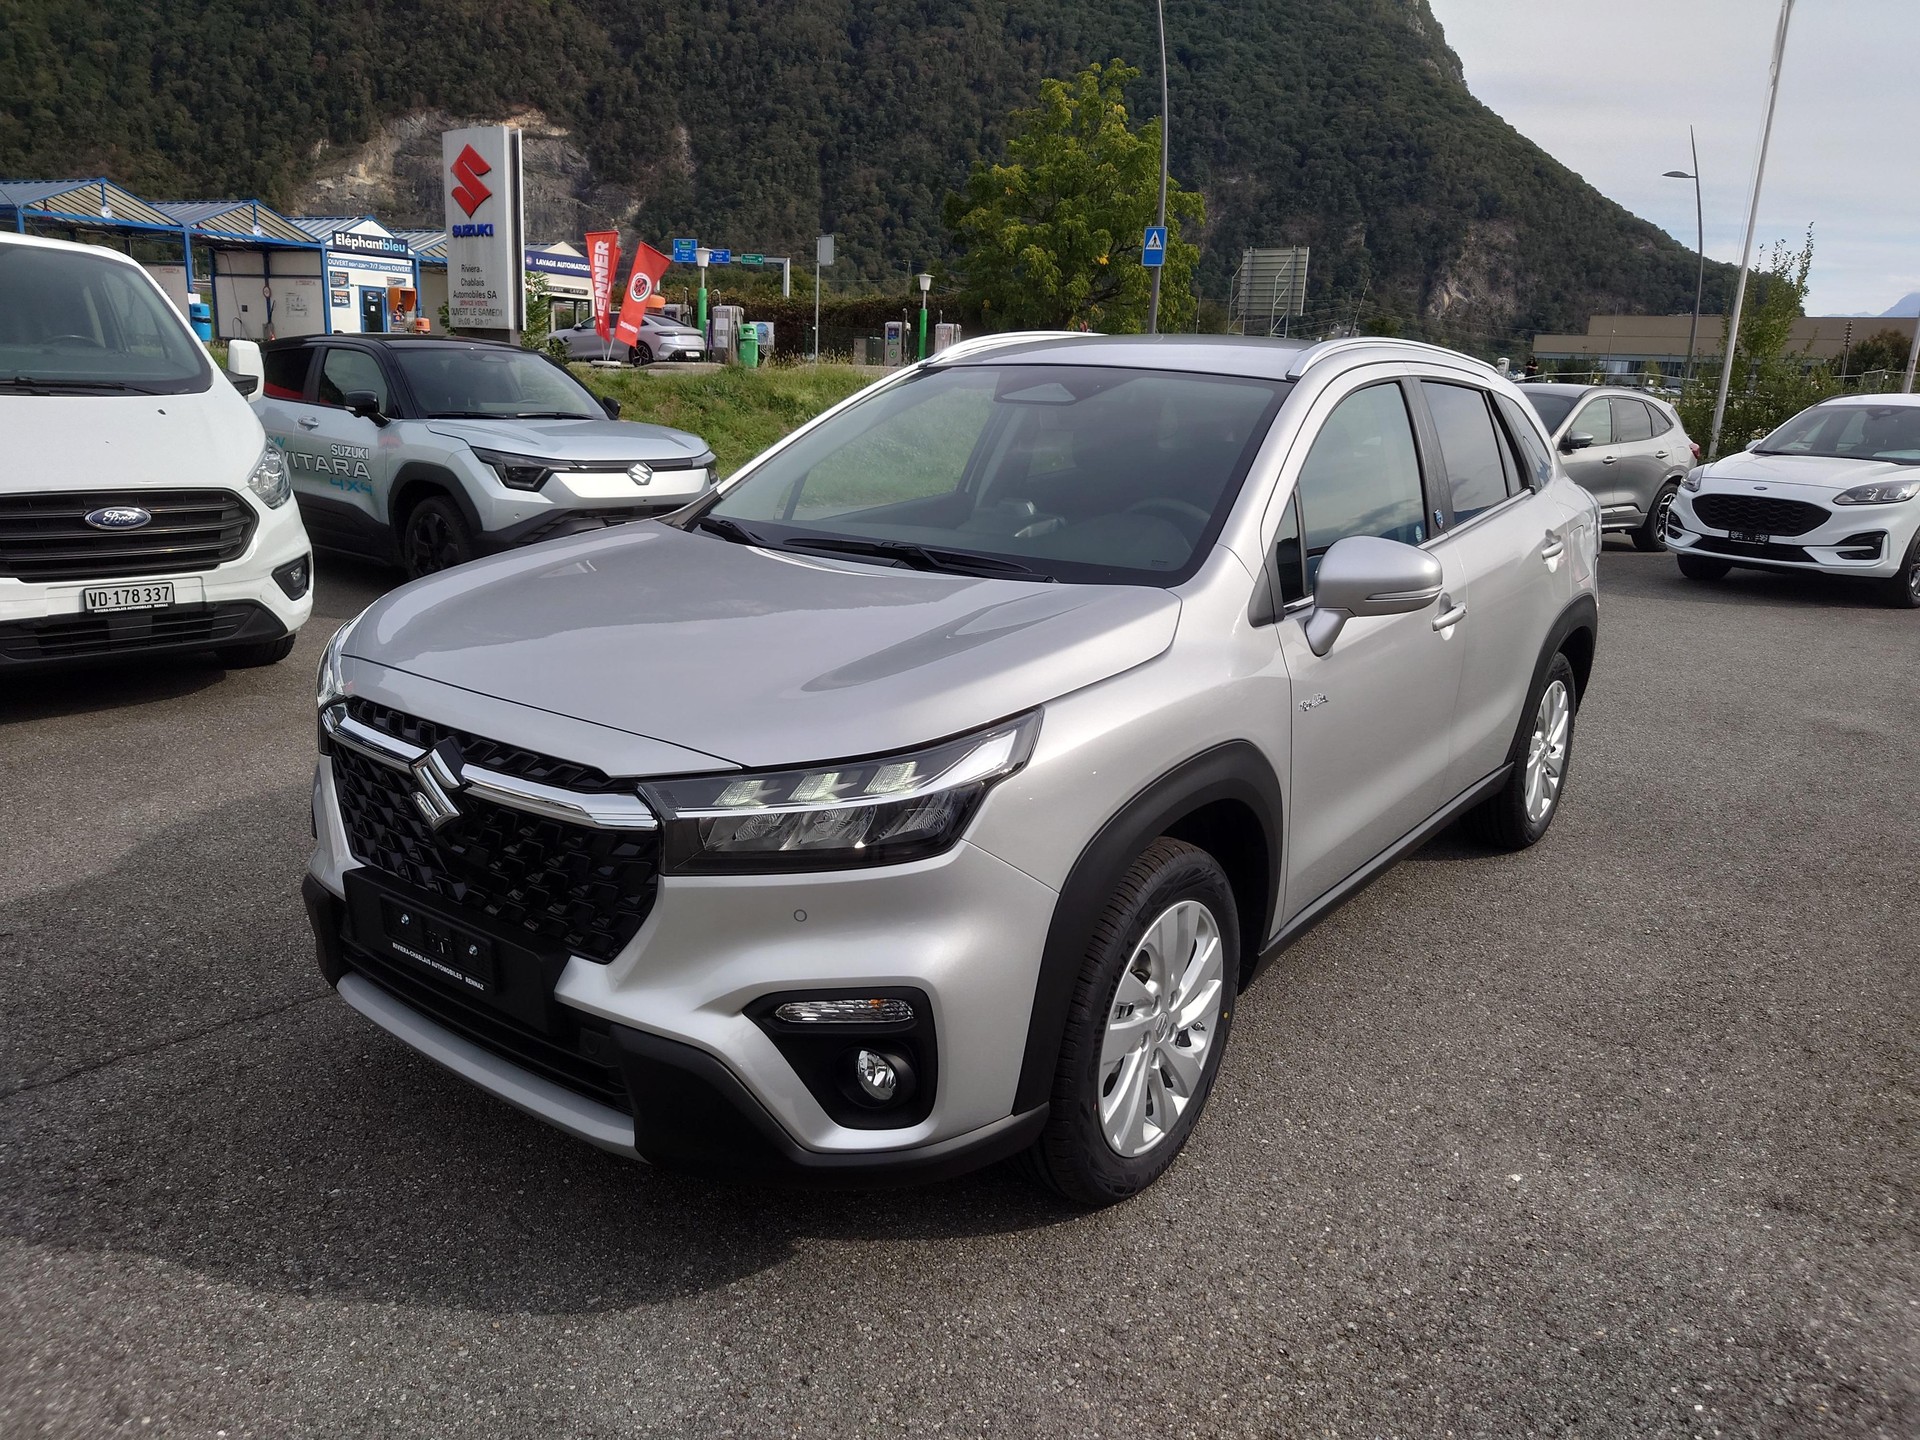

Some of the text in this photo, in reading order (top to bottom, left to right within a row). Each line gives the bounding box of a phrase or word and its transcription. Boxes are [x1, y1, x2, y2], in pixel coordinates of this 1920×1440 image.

[452, 223, 494, 238] SUZUKI
[536, 258, 591, 271] LAVAGE AUTOMATIQU
[460, 277, 485, 287] Chablais
[453, 290, 498, 299] Automobiles SA
[451, 308, 503, 317] OUVERT LE SAMEDI
[330, 444, 370, 460] SUZUKI
[102, 510, 139, 524] Ford
[431, 961, 463, 980] AUTOMOBILES
